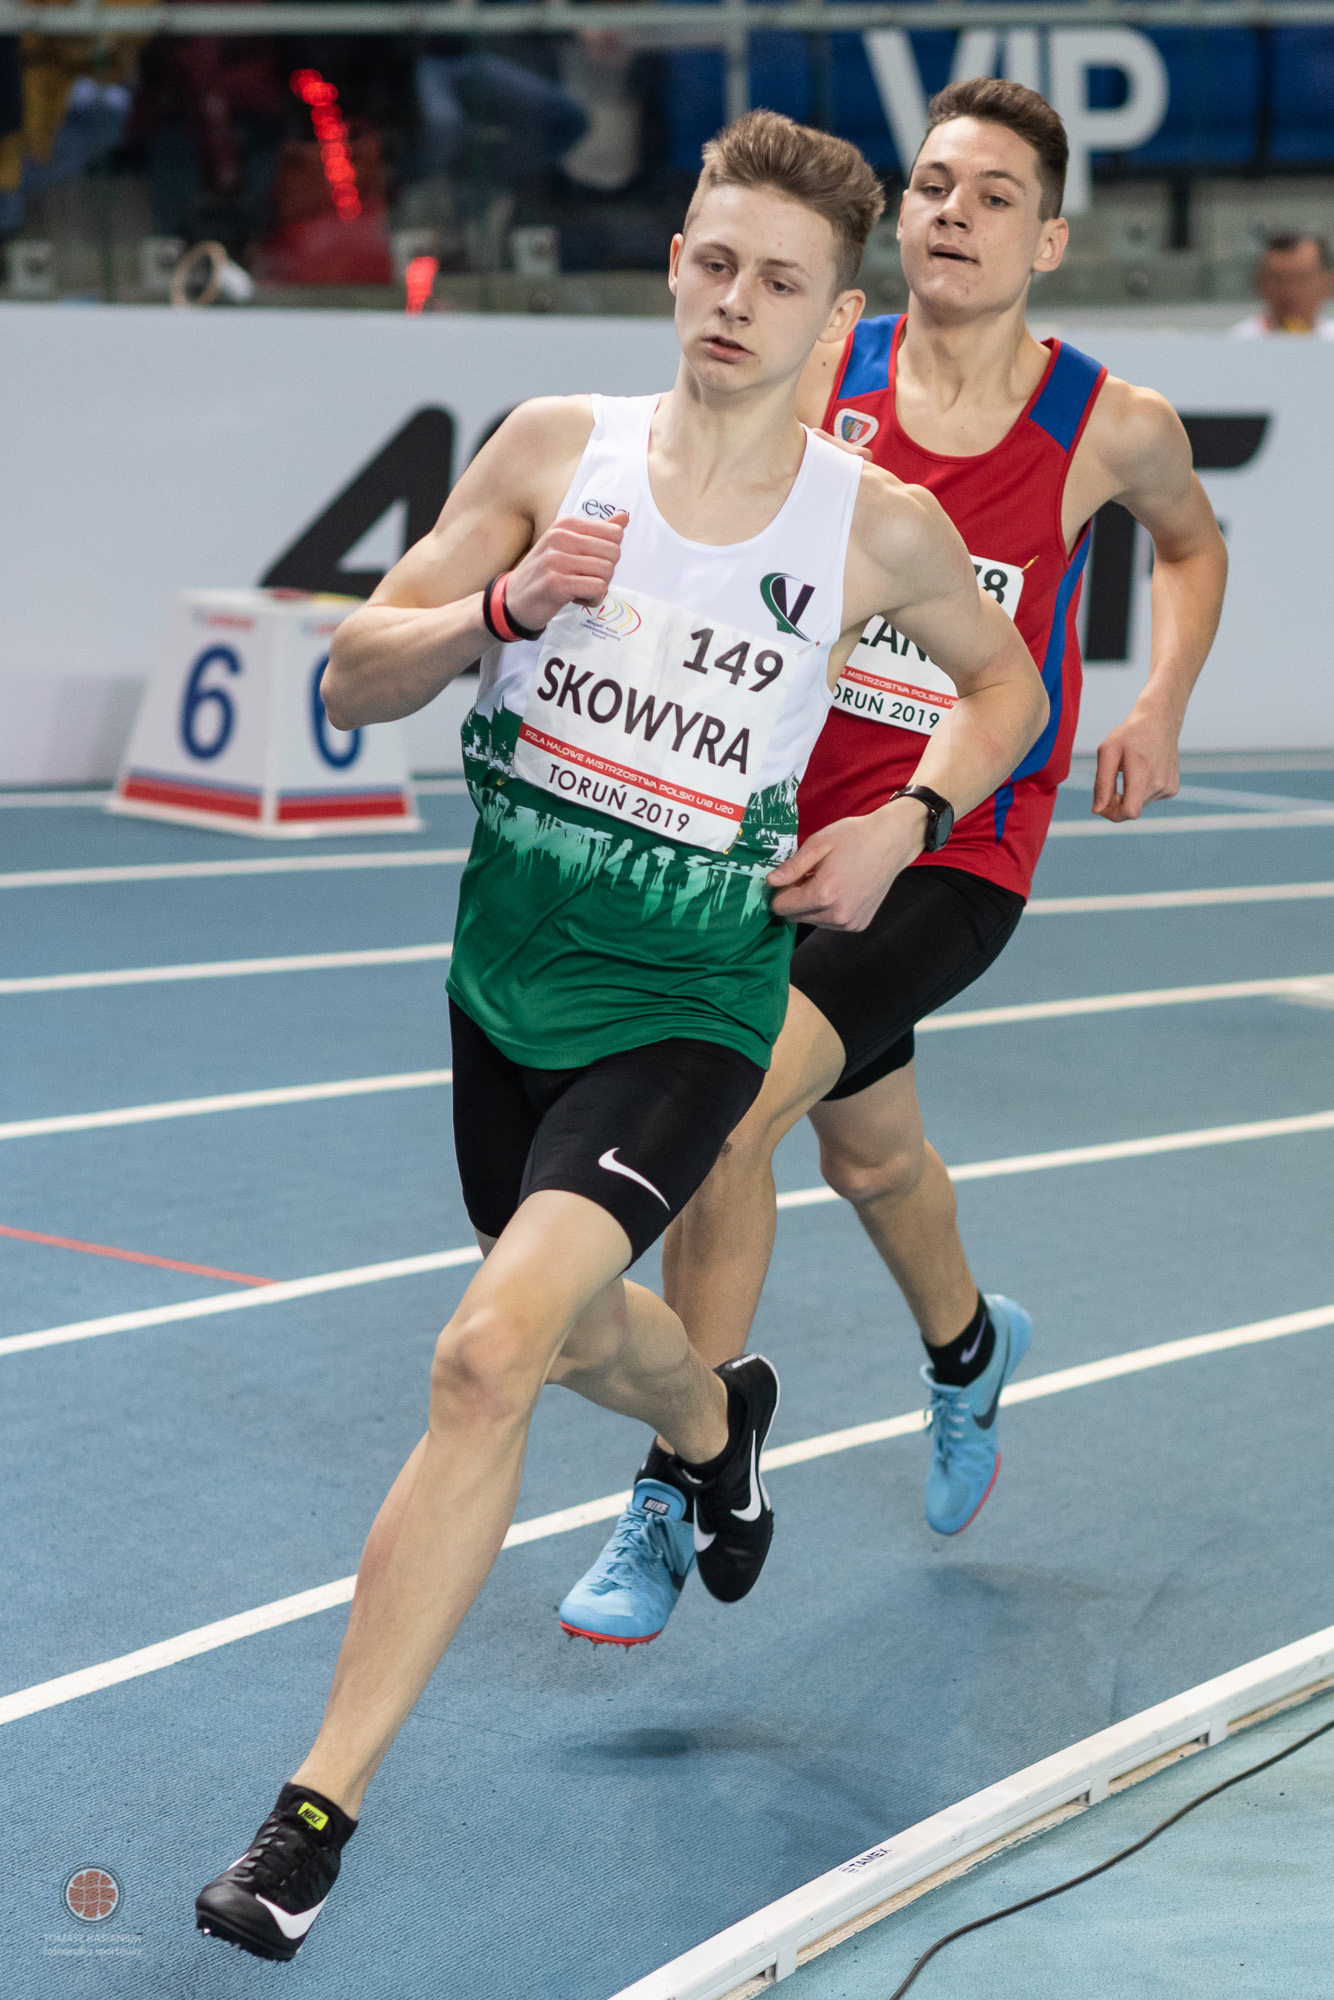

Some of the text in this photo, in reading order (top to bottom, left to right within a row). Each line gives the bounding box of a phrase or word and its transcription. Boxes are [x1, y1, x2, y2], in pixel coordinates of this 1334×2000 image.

[973, 564, 1008, 604] 8
[682, 627, 784, 692] 149
[847, 670, 910, 694] MISTRZOSTWA
[911, 687, 942, 703] POLSKI
[180, 643, 242, 762] 6
[536, 656, 750, 775] SKOWYRA
[834, 683, 940, 728] ORUŃ 2019
[525, 729, 734, 815] PZLA HALOWE MISTRZOSTWA POLSKI U18 U20
[549, 763, 690, 832] TORUŃ 2019
[300, 1808, 323, 1824] NIKE
